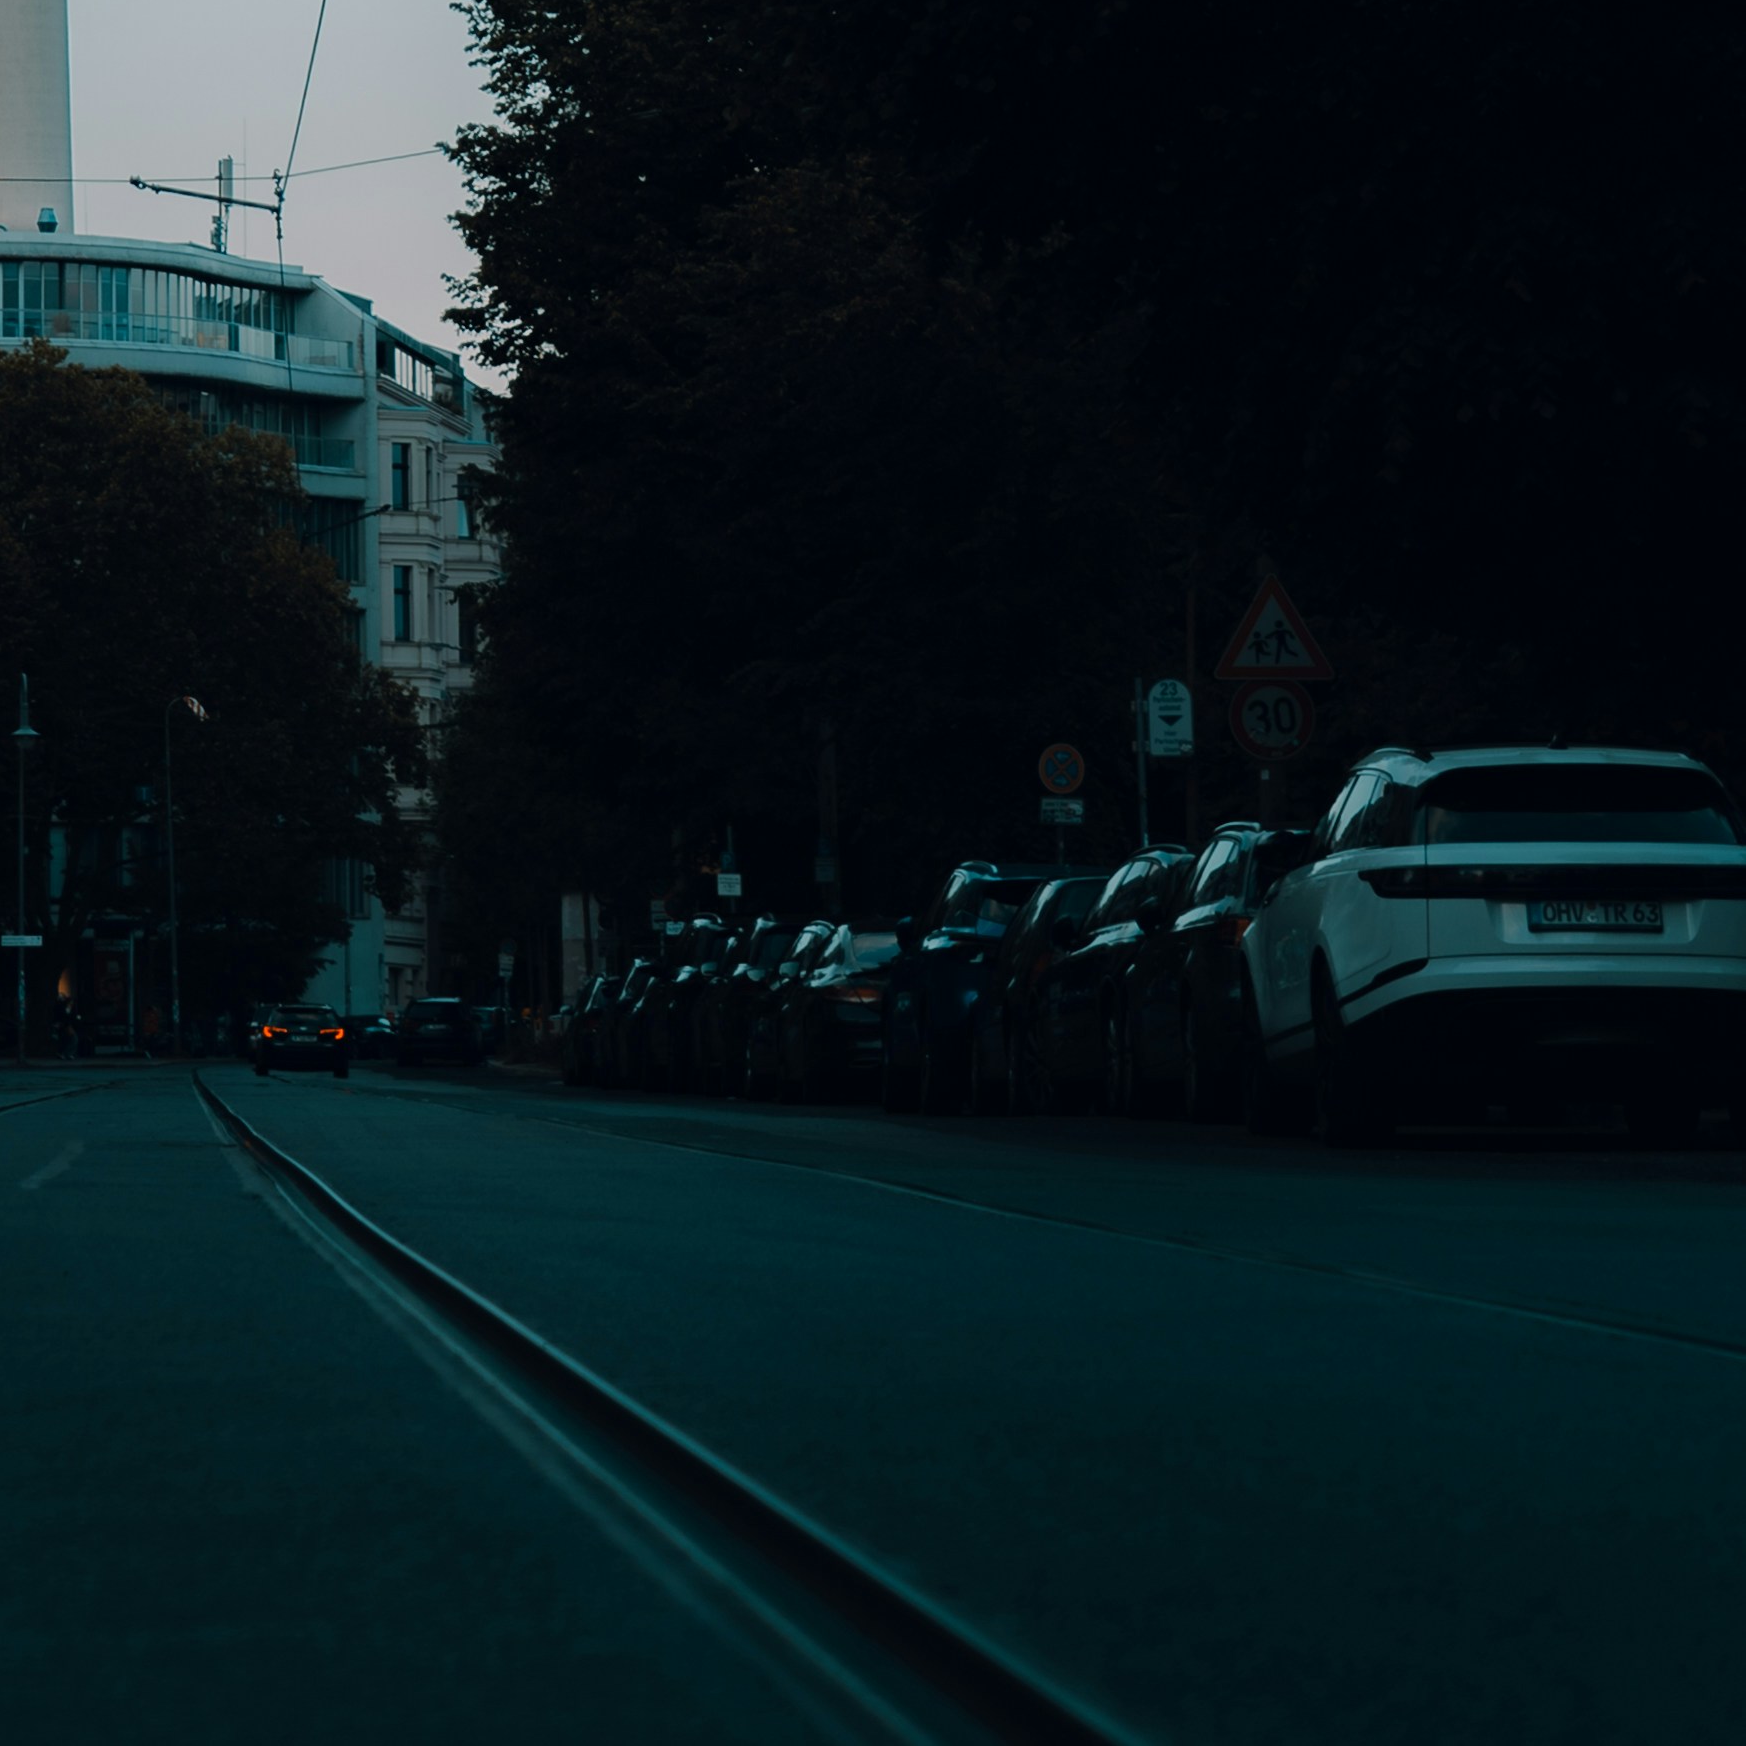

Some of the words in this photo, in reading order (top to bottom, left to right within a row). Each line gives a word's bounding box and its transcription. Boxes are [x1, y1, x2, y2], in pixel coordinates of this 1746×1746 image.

[1160, 681, 1178, 696] 23
[1248, 697, 1296, 734] 30
[1542, 903, 1584, 922] OHV
[1600, 903, 1628, 923] TR
[1633, 903, 1659, 923] 63
